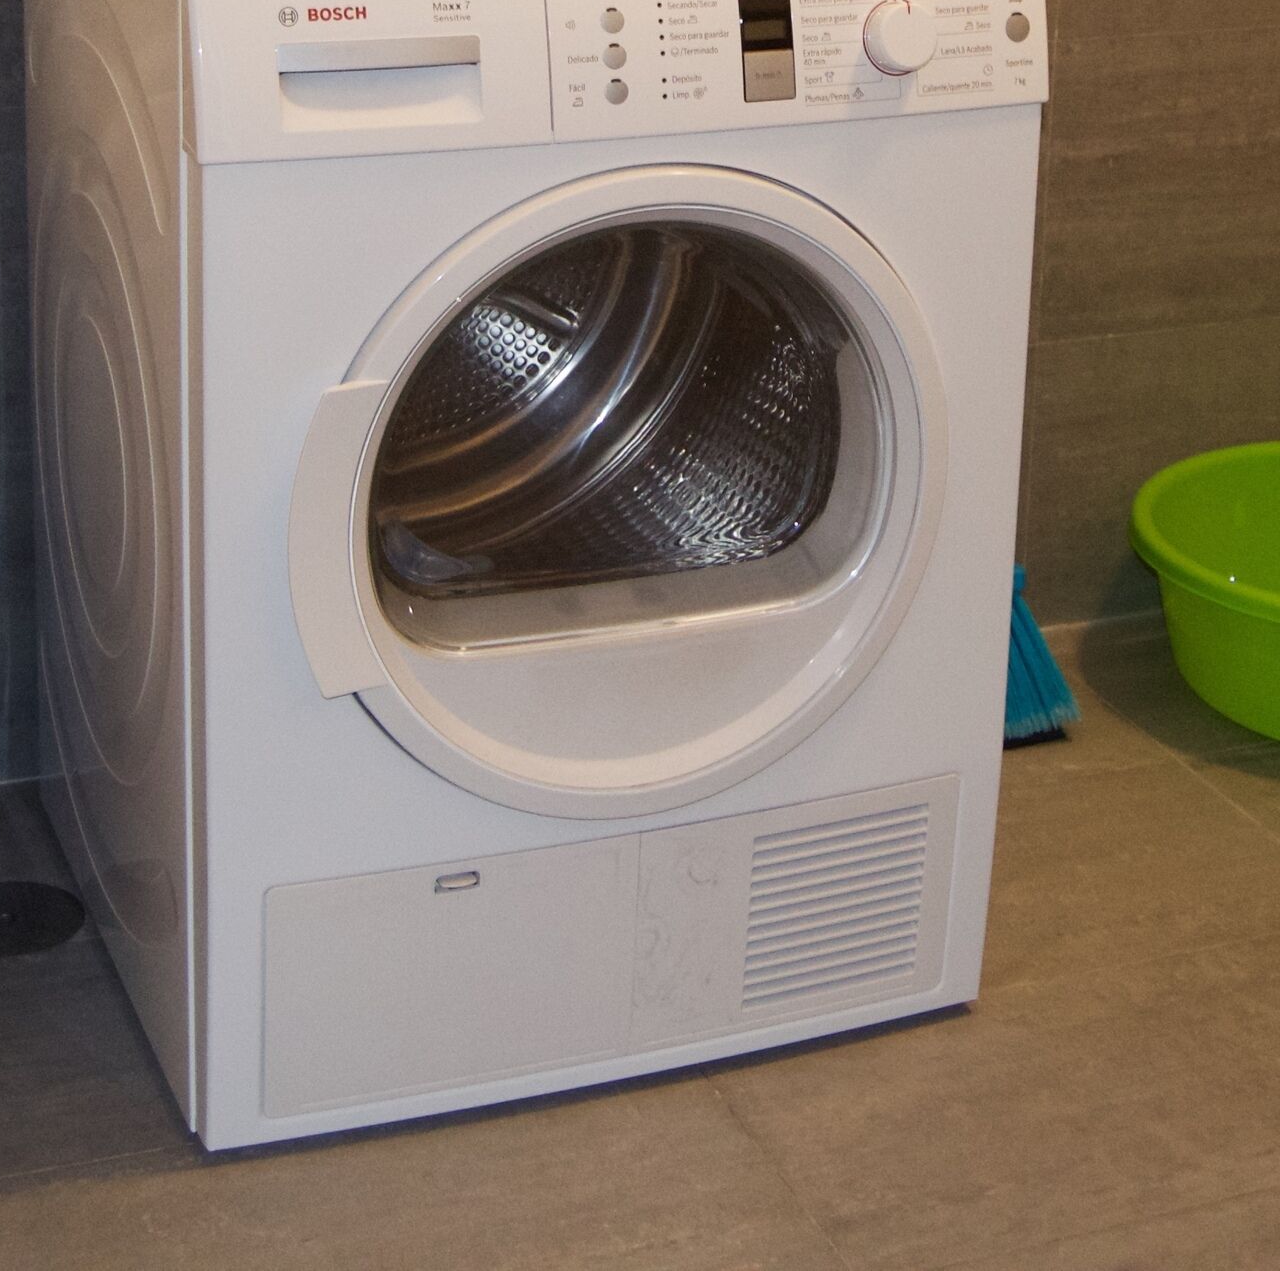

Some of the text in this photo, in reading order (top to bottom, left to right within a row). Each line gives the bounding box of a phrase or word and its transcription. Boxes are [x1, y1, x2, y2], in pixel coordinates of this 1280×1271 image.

[432, 0, 471, 12] Maxx 7
[307, 6, 368, 22] BOSCH
[433, 13, 472, 23] Sensitive
[668, 17, 686, 26] Seco
[669, 29, 730, 42] Seco para guardar
[567, 54, 599, 66] Delicado
[804, 76, 823, 86] Sport
